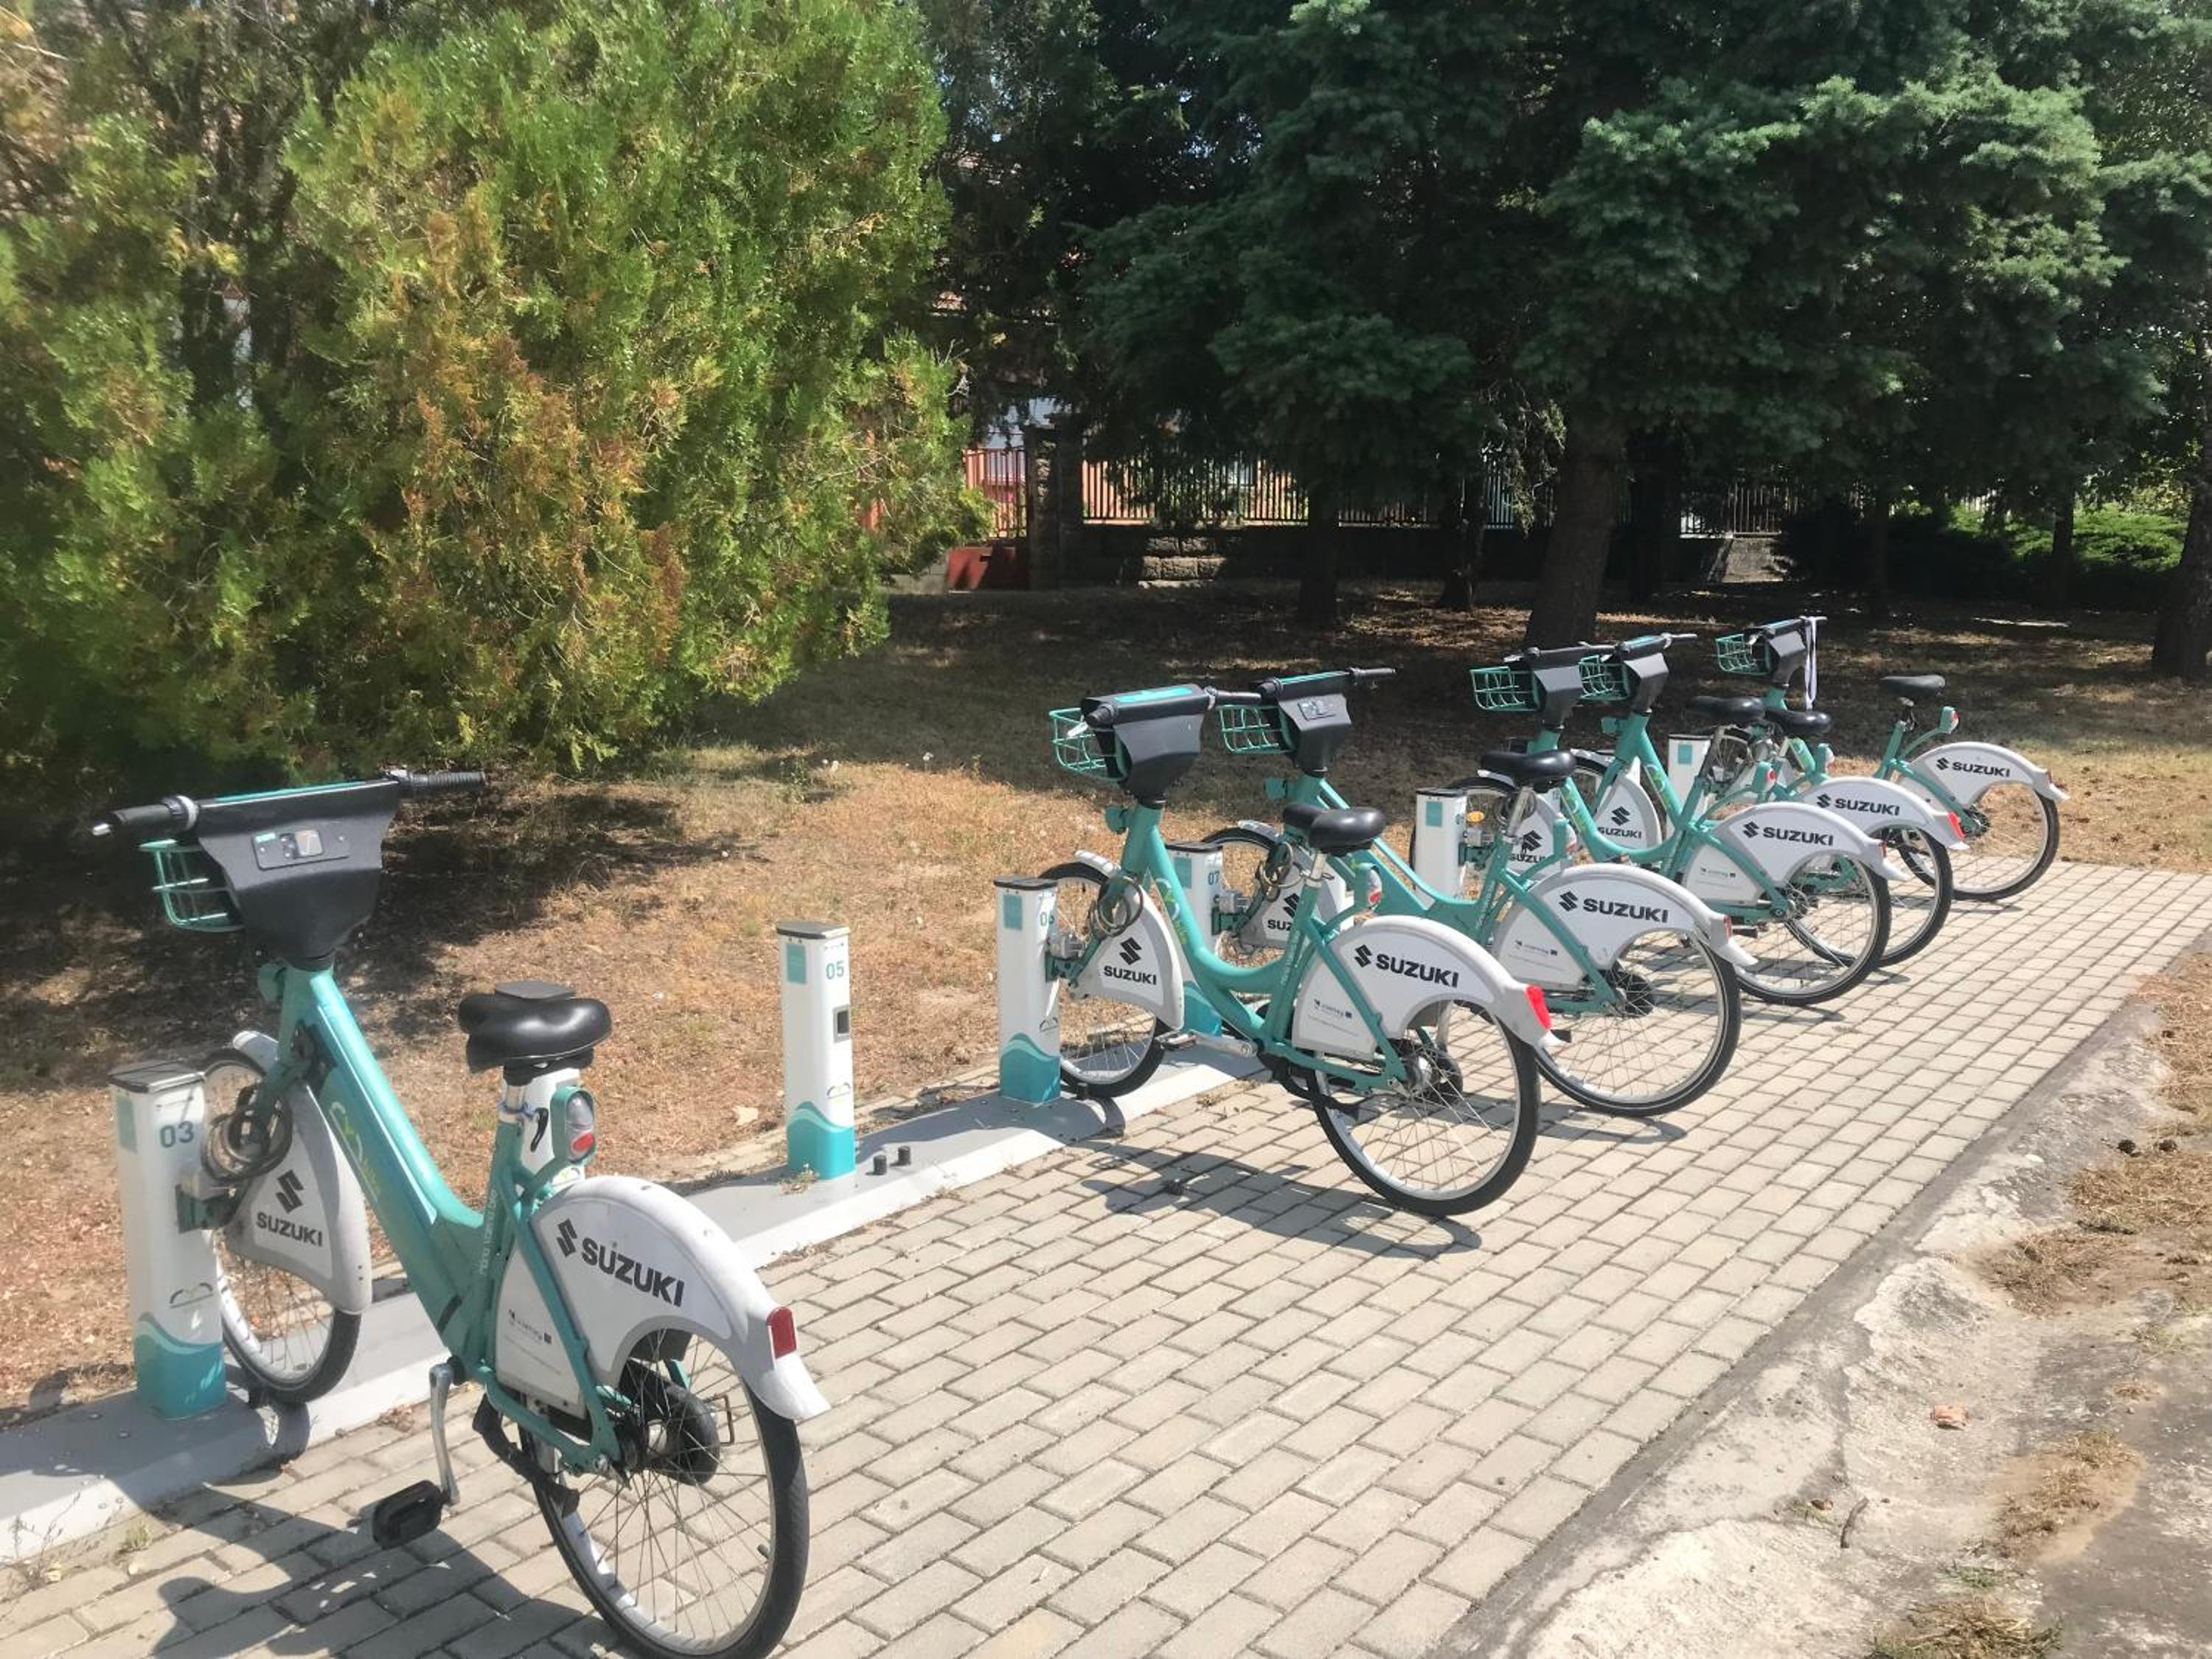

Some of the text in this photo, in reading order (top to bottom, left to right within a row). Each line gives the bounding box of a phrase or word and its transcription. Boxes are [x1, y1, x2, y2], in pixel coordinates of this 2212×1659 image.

[1952, 762, 2010, 777] SUZUKI
[1835, 799, 1900, 816] SUZUKI
[1598, 827, 1641, 838] SUZUKI
[1763, 827, 1833, 846] SUZUKI
[1511, 853, 1545, 863] SUZU
[1208, 871, 1220, 885] 07
[1583, 898, 1669, 923] SUZUKI
[1267, 919, 1293, 931] SUZ
[826, 960, 844, 979] 05
[1104, 965, 1157, 985] SUZUKI
[1375, 953, 1459, 988] SUZUKI
[159, 1121, 195, 1148] 03
[256, 1211, 323, 1247] SUZUKI
[581, 1237, 684, 1307] SUZUKI
